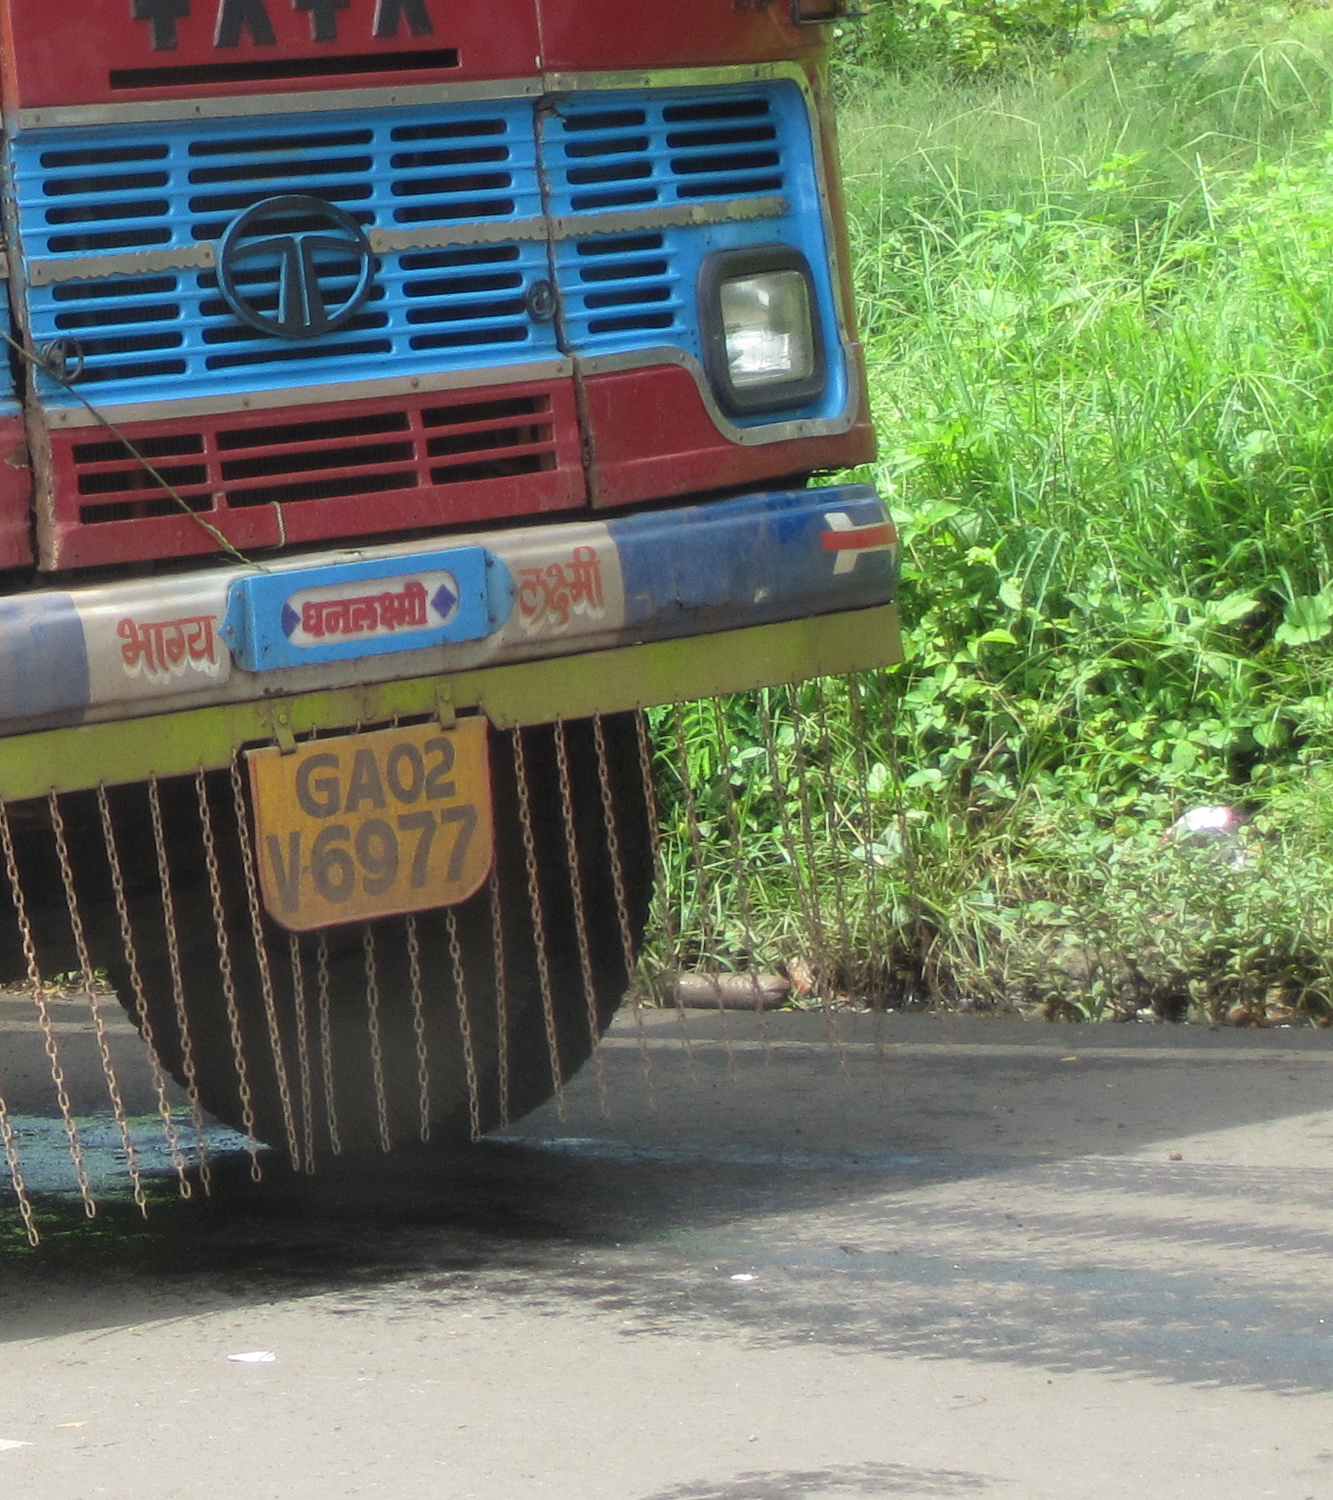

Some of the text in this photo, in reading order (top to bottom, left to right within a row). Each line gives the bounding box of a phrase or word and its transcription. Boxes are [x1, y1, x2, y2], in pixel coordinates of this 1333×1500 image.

[301, 581, 429, 637] धनलक्ष्मी
[117, 617, 218, 675] भाग्य
[295, 737, 456, 819] GA02
